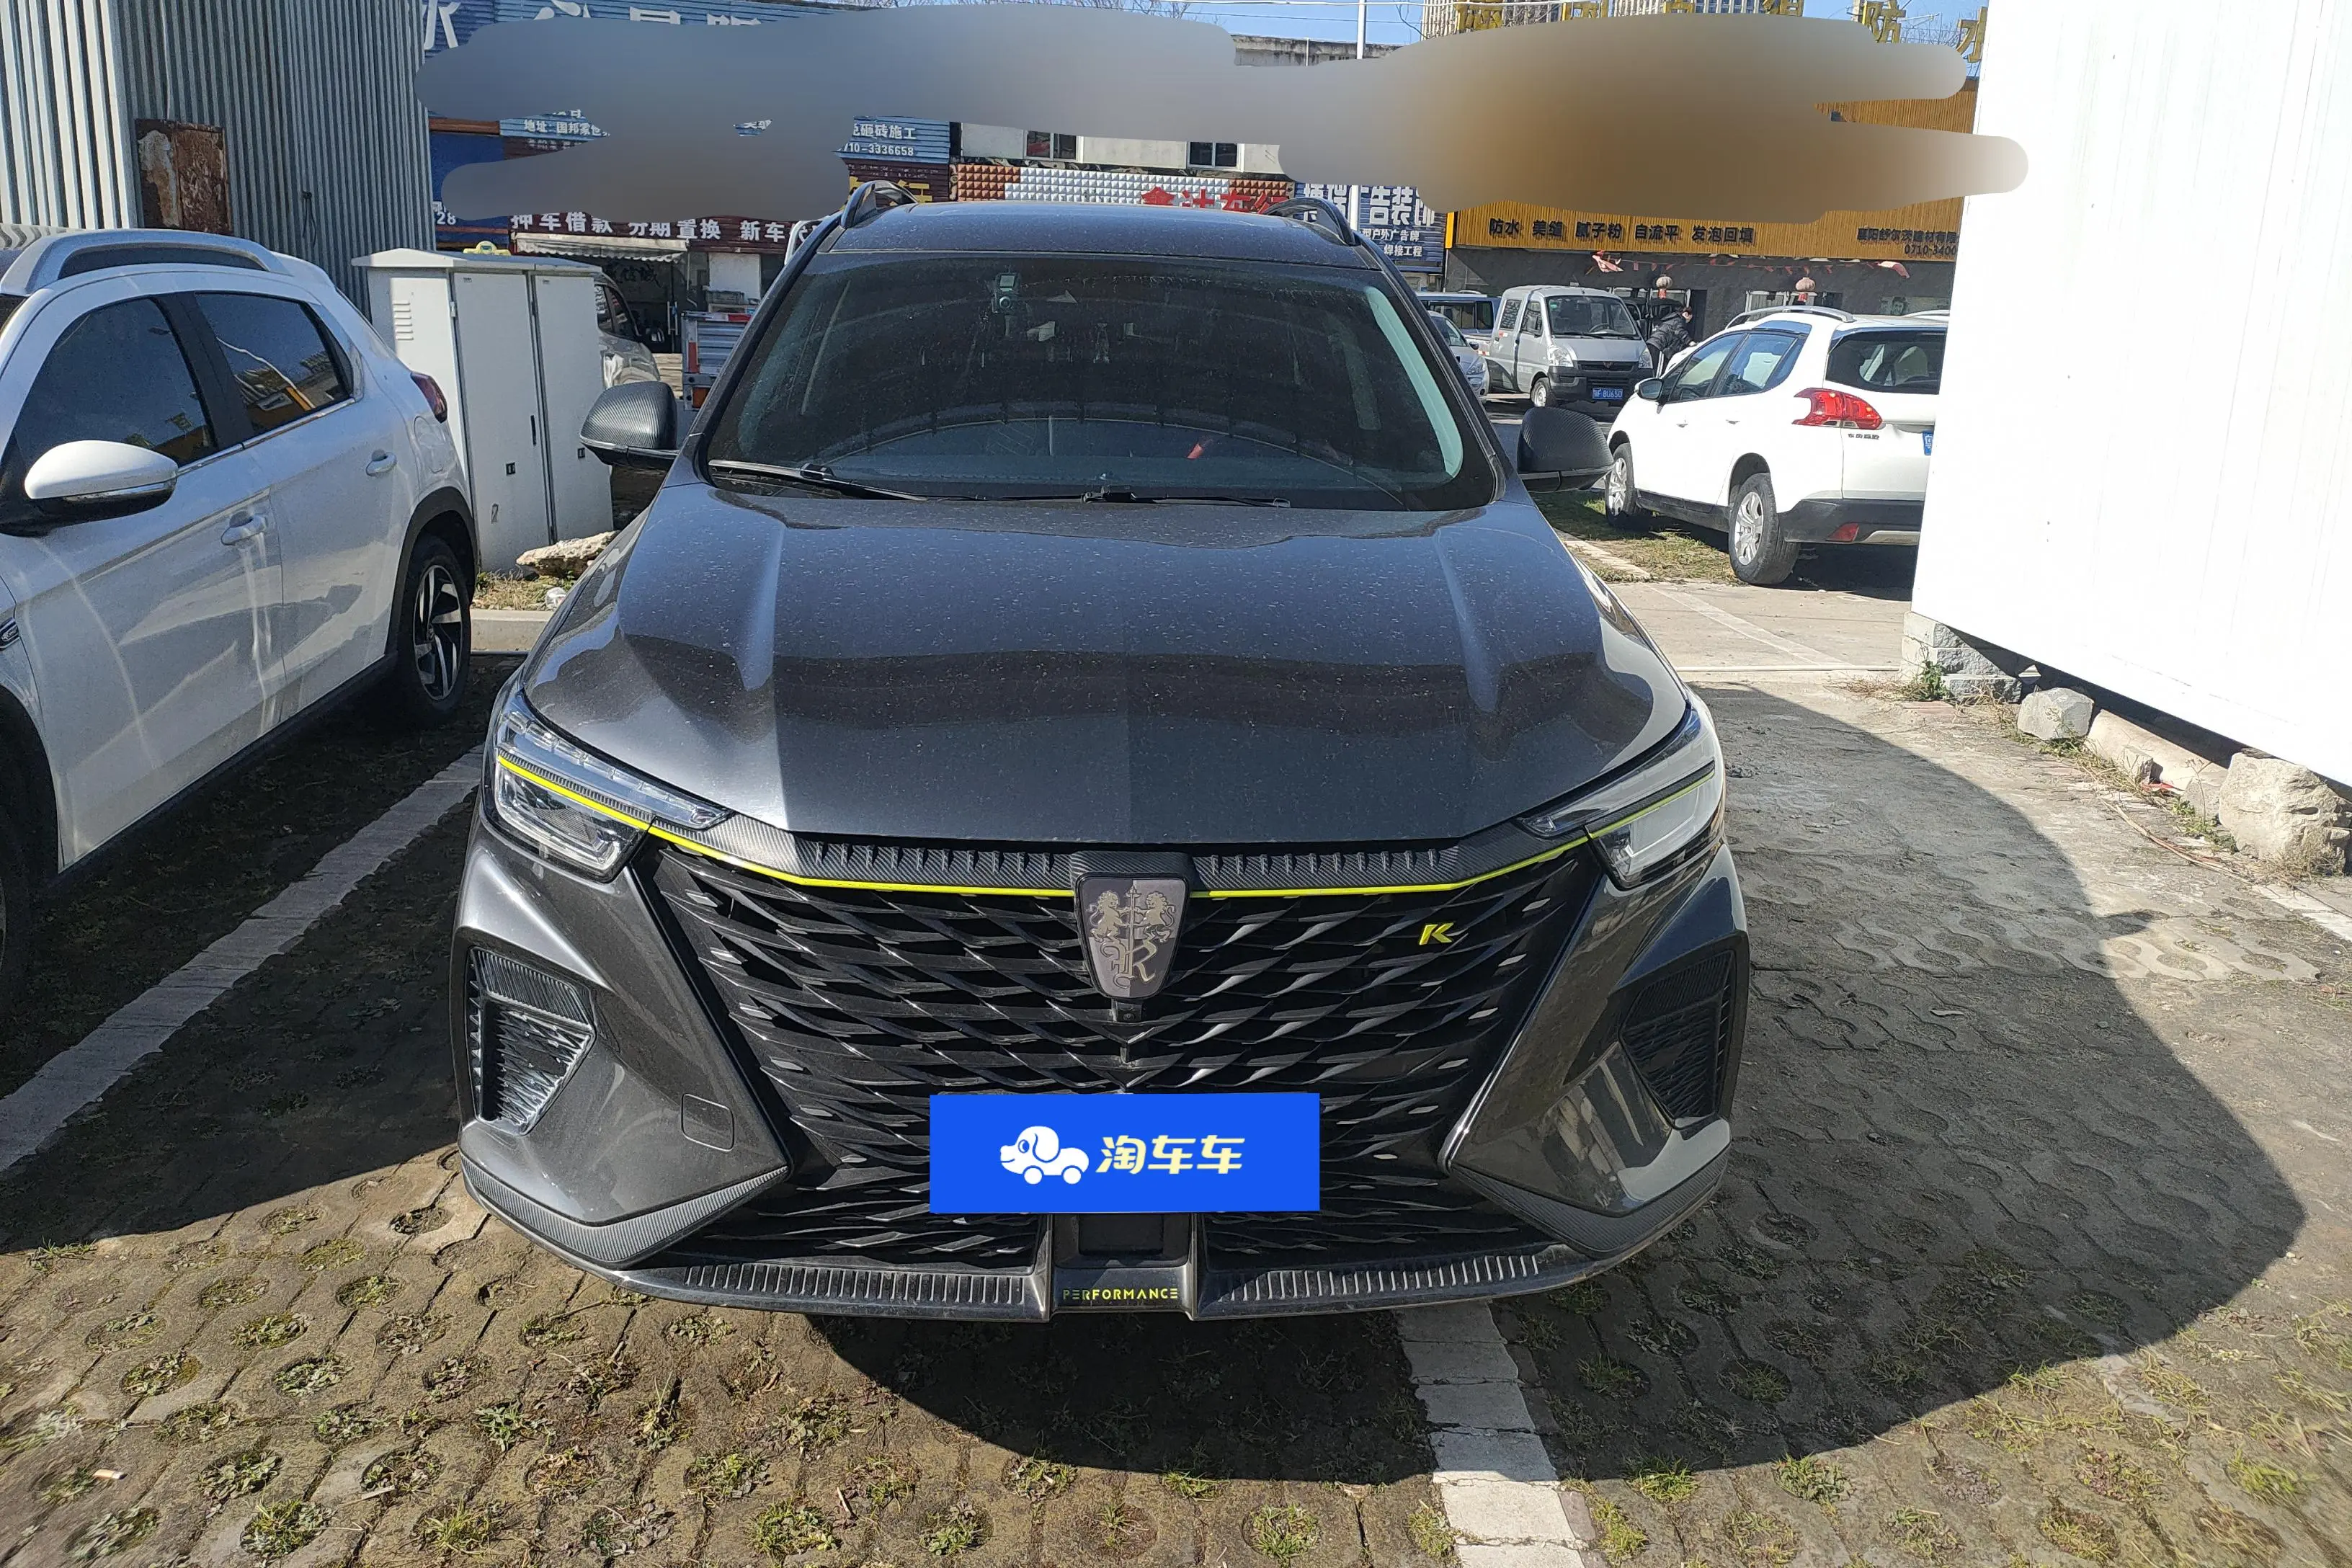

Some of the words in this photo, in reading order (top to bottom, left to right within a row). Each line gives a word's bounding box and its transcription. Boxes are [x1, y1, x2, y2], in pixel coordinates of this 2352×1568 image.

[1489, 218, 1520, 236] 防水
[1533, 219, 1564, 237] 美缝
[1576, 220, 1622, 239] 腻子粉
[1635, 223, 1680, 241] 自流平
[1692, 225, 1755, 244] 发泡回填
[1384, 244, 1422, 257] 焊接工程
[1062, 1288, 1179, 1301] PERFORMANCE
